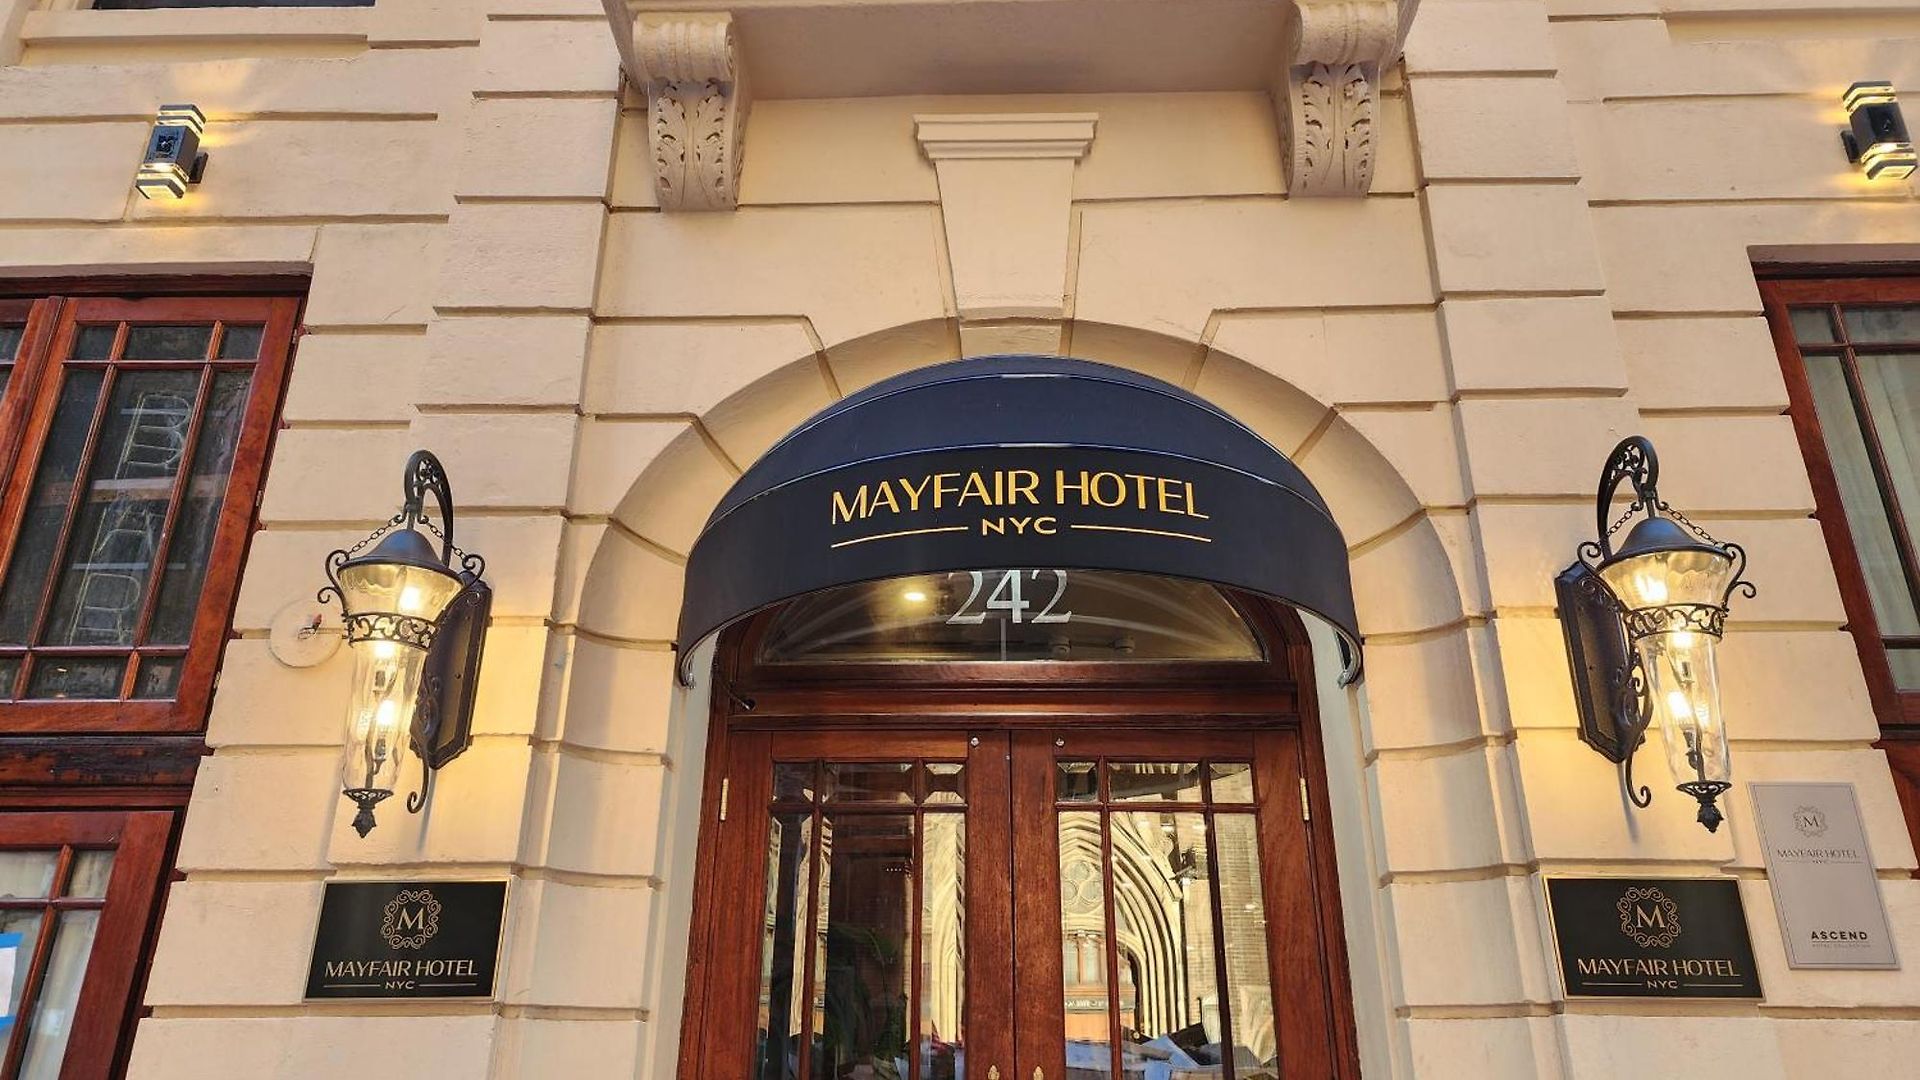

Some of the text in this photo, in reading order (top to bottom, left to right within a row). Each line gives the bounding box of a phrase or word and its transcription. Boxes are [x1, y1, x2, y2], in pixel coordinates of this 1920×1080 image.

[832, 469, 1211, 525] MAYFAIR HOTEL
[982, 517, 1057, 536] NYC
[945, 569, 1072, 625] 242
[397, 907, 425, 930] M
[1636, 904, 1666, 928] M
[1811, 931, 1868, 940] ASCEND
[325, 960, 478, 978] MAYFAIR HOTEL
[1577, 958, 1741, 977] MAYFAIR HOTEL
[385, 981, 415, 990] NYC
[1646, 980, 1678, 989] NYC
